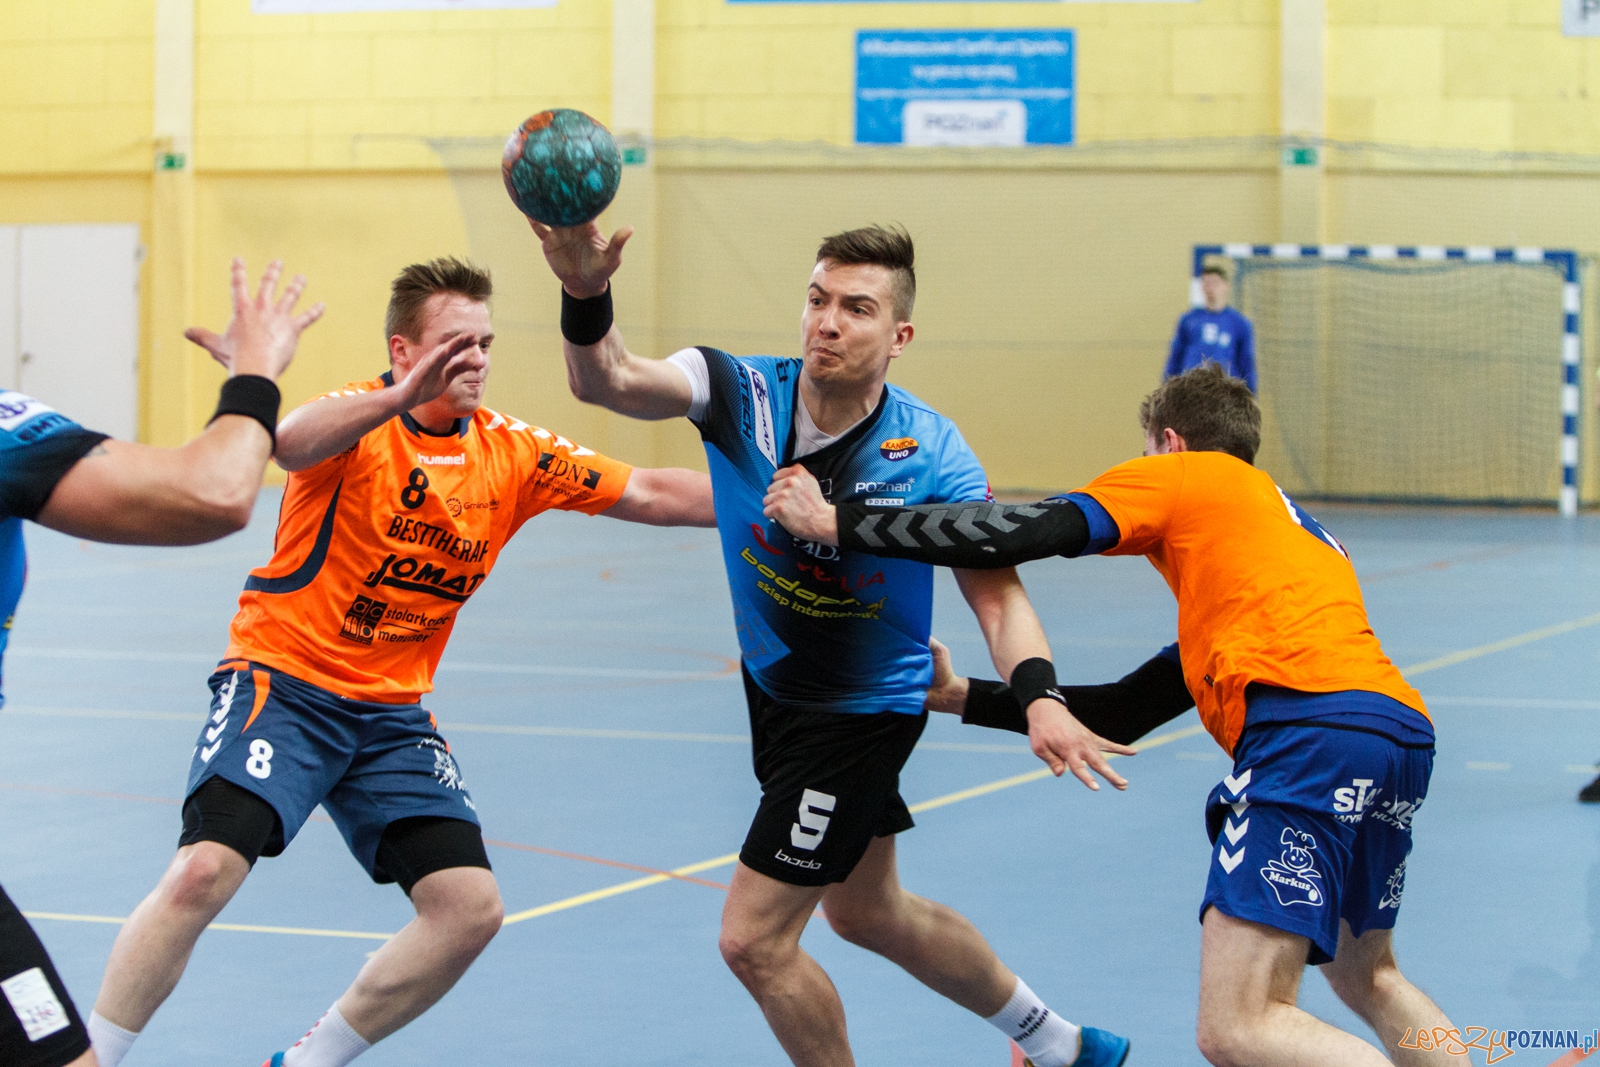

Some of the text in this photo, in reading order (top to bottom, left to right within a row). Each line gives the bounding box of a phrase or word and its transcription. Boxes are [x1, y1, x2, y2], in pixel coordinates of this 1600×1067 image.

[730, 357, 752, 440] MTECH
[885, 439, 915, 449] KANTOR
[889, 449, 909, 460] UNO
[417, 453, 465, 465] hummel
[546, 455, 584, 483] CDN
[401, 467, 429, 510] 8
[463, 501, 489, 510] Gmina
[756, 580, 790, 606] sklep
[246, 738, 274, 779] 8
[790, 787, 837, 851] 5
[774, 848, 822, 870] bodo
[1268, 871, 1311, 892] Markus
